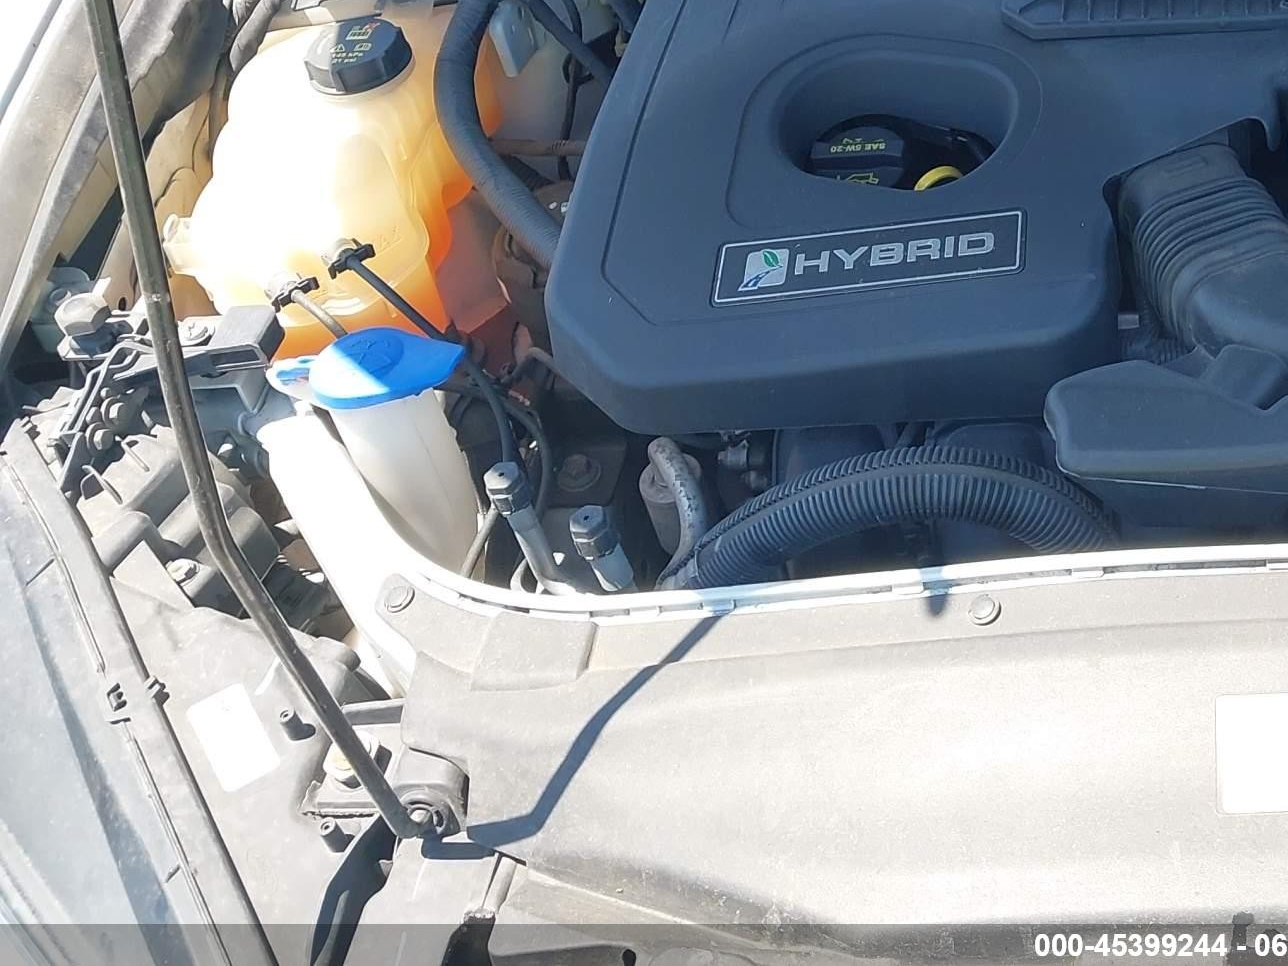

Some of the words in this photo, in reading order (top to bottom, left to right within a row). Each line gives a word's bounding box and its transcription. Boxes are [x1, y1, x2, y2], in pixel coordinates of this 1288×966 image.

[830, 144, 863, 153] 5W-20
[865, 142, 886, 151] SAE
[793, 232, 996, 275] HYBRID
